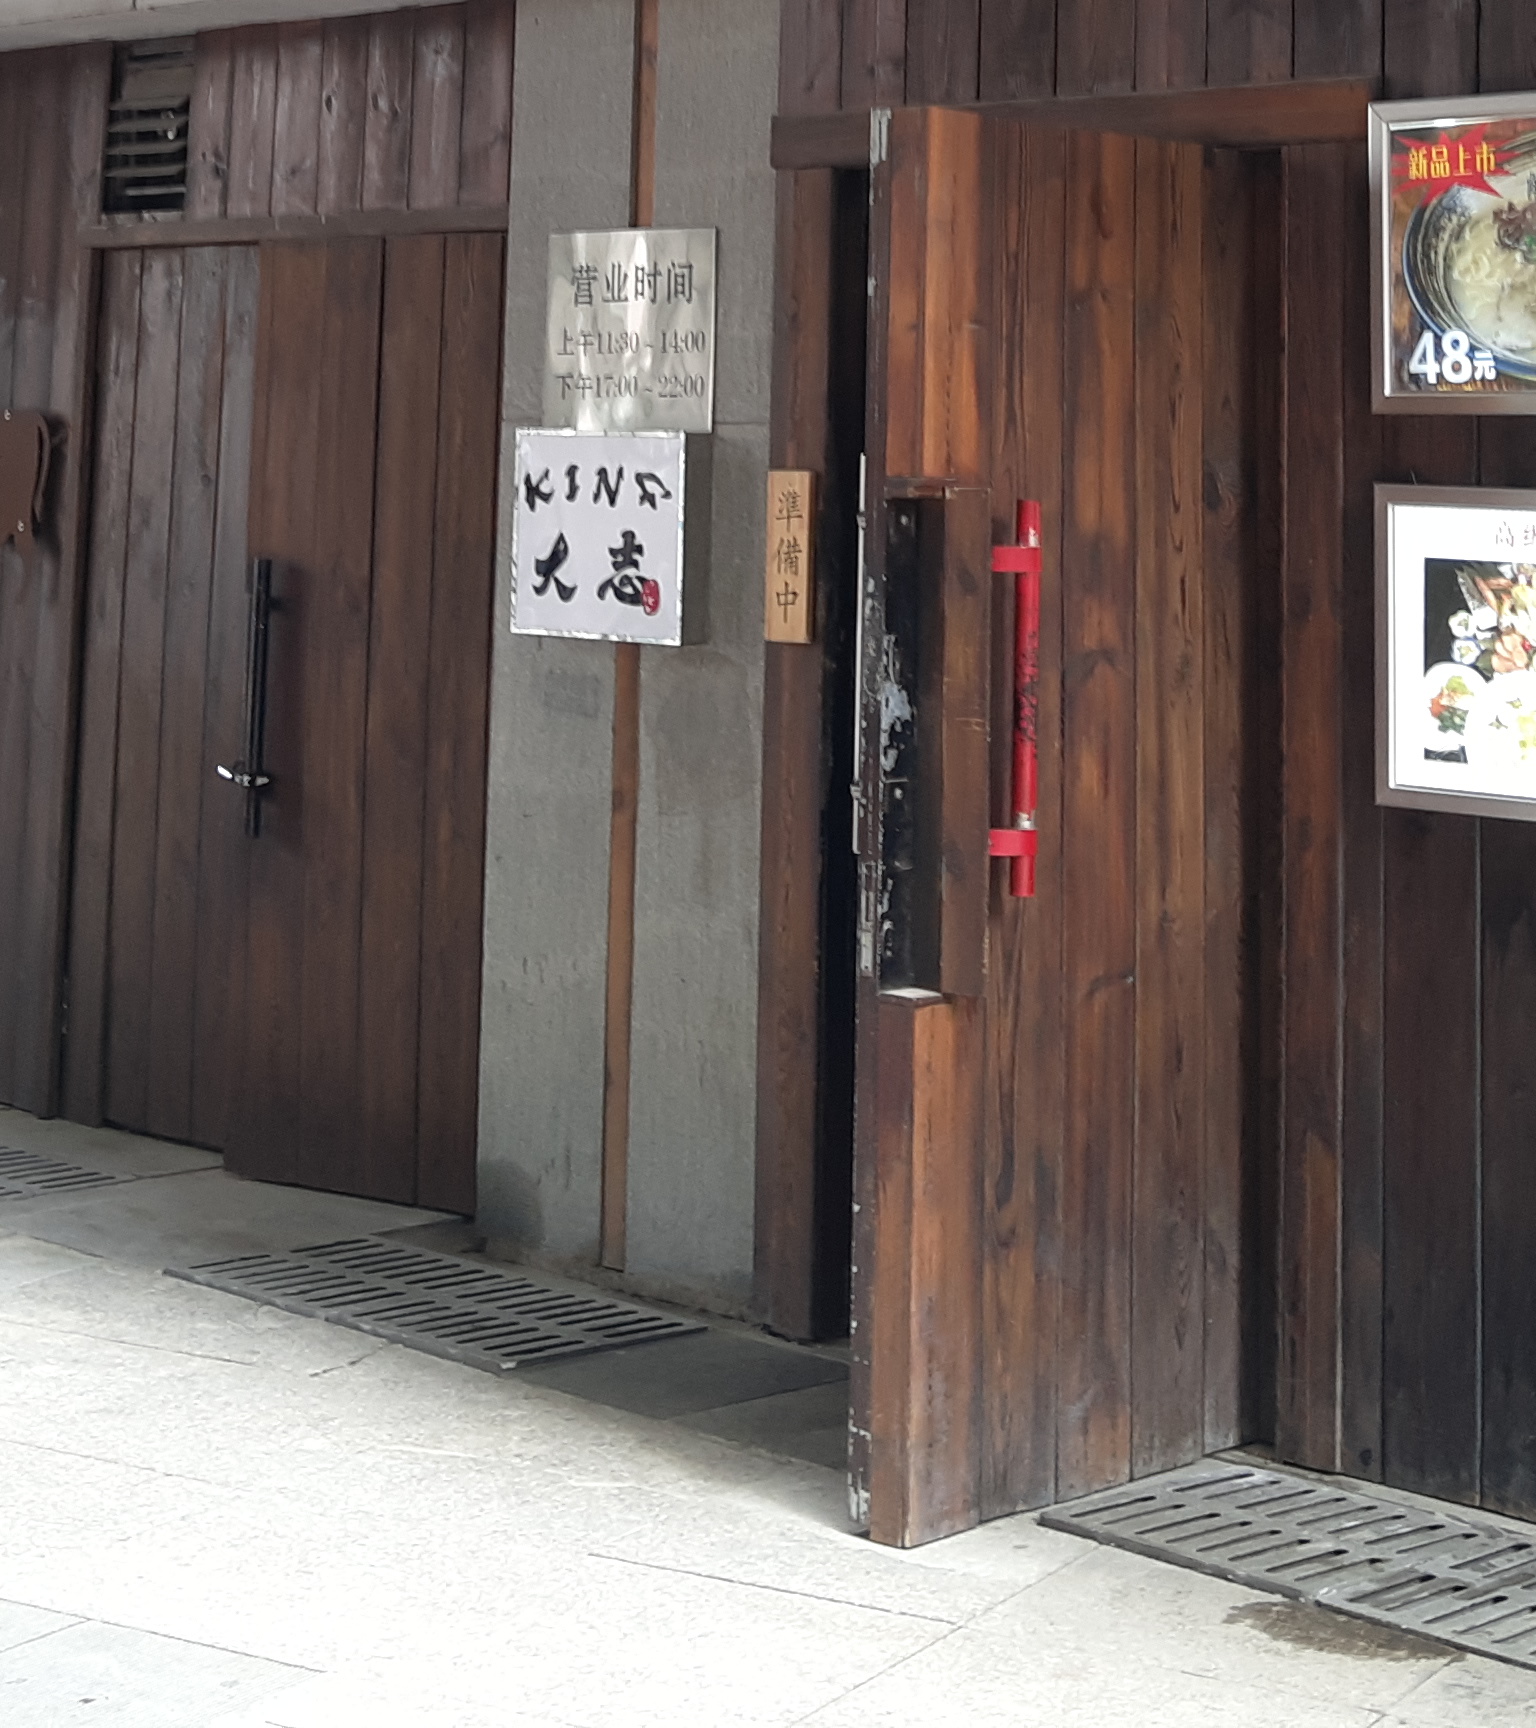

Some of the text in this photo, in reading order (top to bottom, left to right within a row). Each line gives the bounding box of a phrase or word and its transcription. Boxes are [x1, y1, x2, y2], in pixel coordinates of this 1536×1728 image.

[1408, 141, 1496, 180] 新品上市
[571, 260, 695, 307] 营业时间
[522, 464, 673, 513] KING
[531, 529, 650, 607] 大志
[774, 487, 805, 624] 準備中
